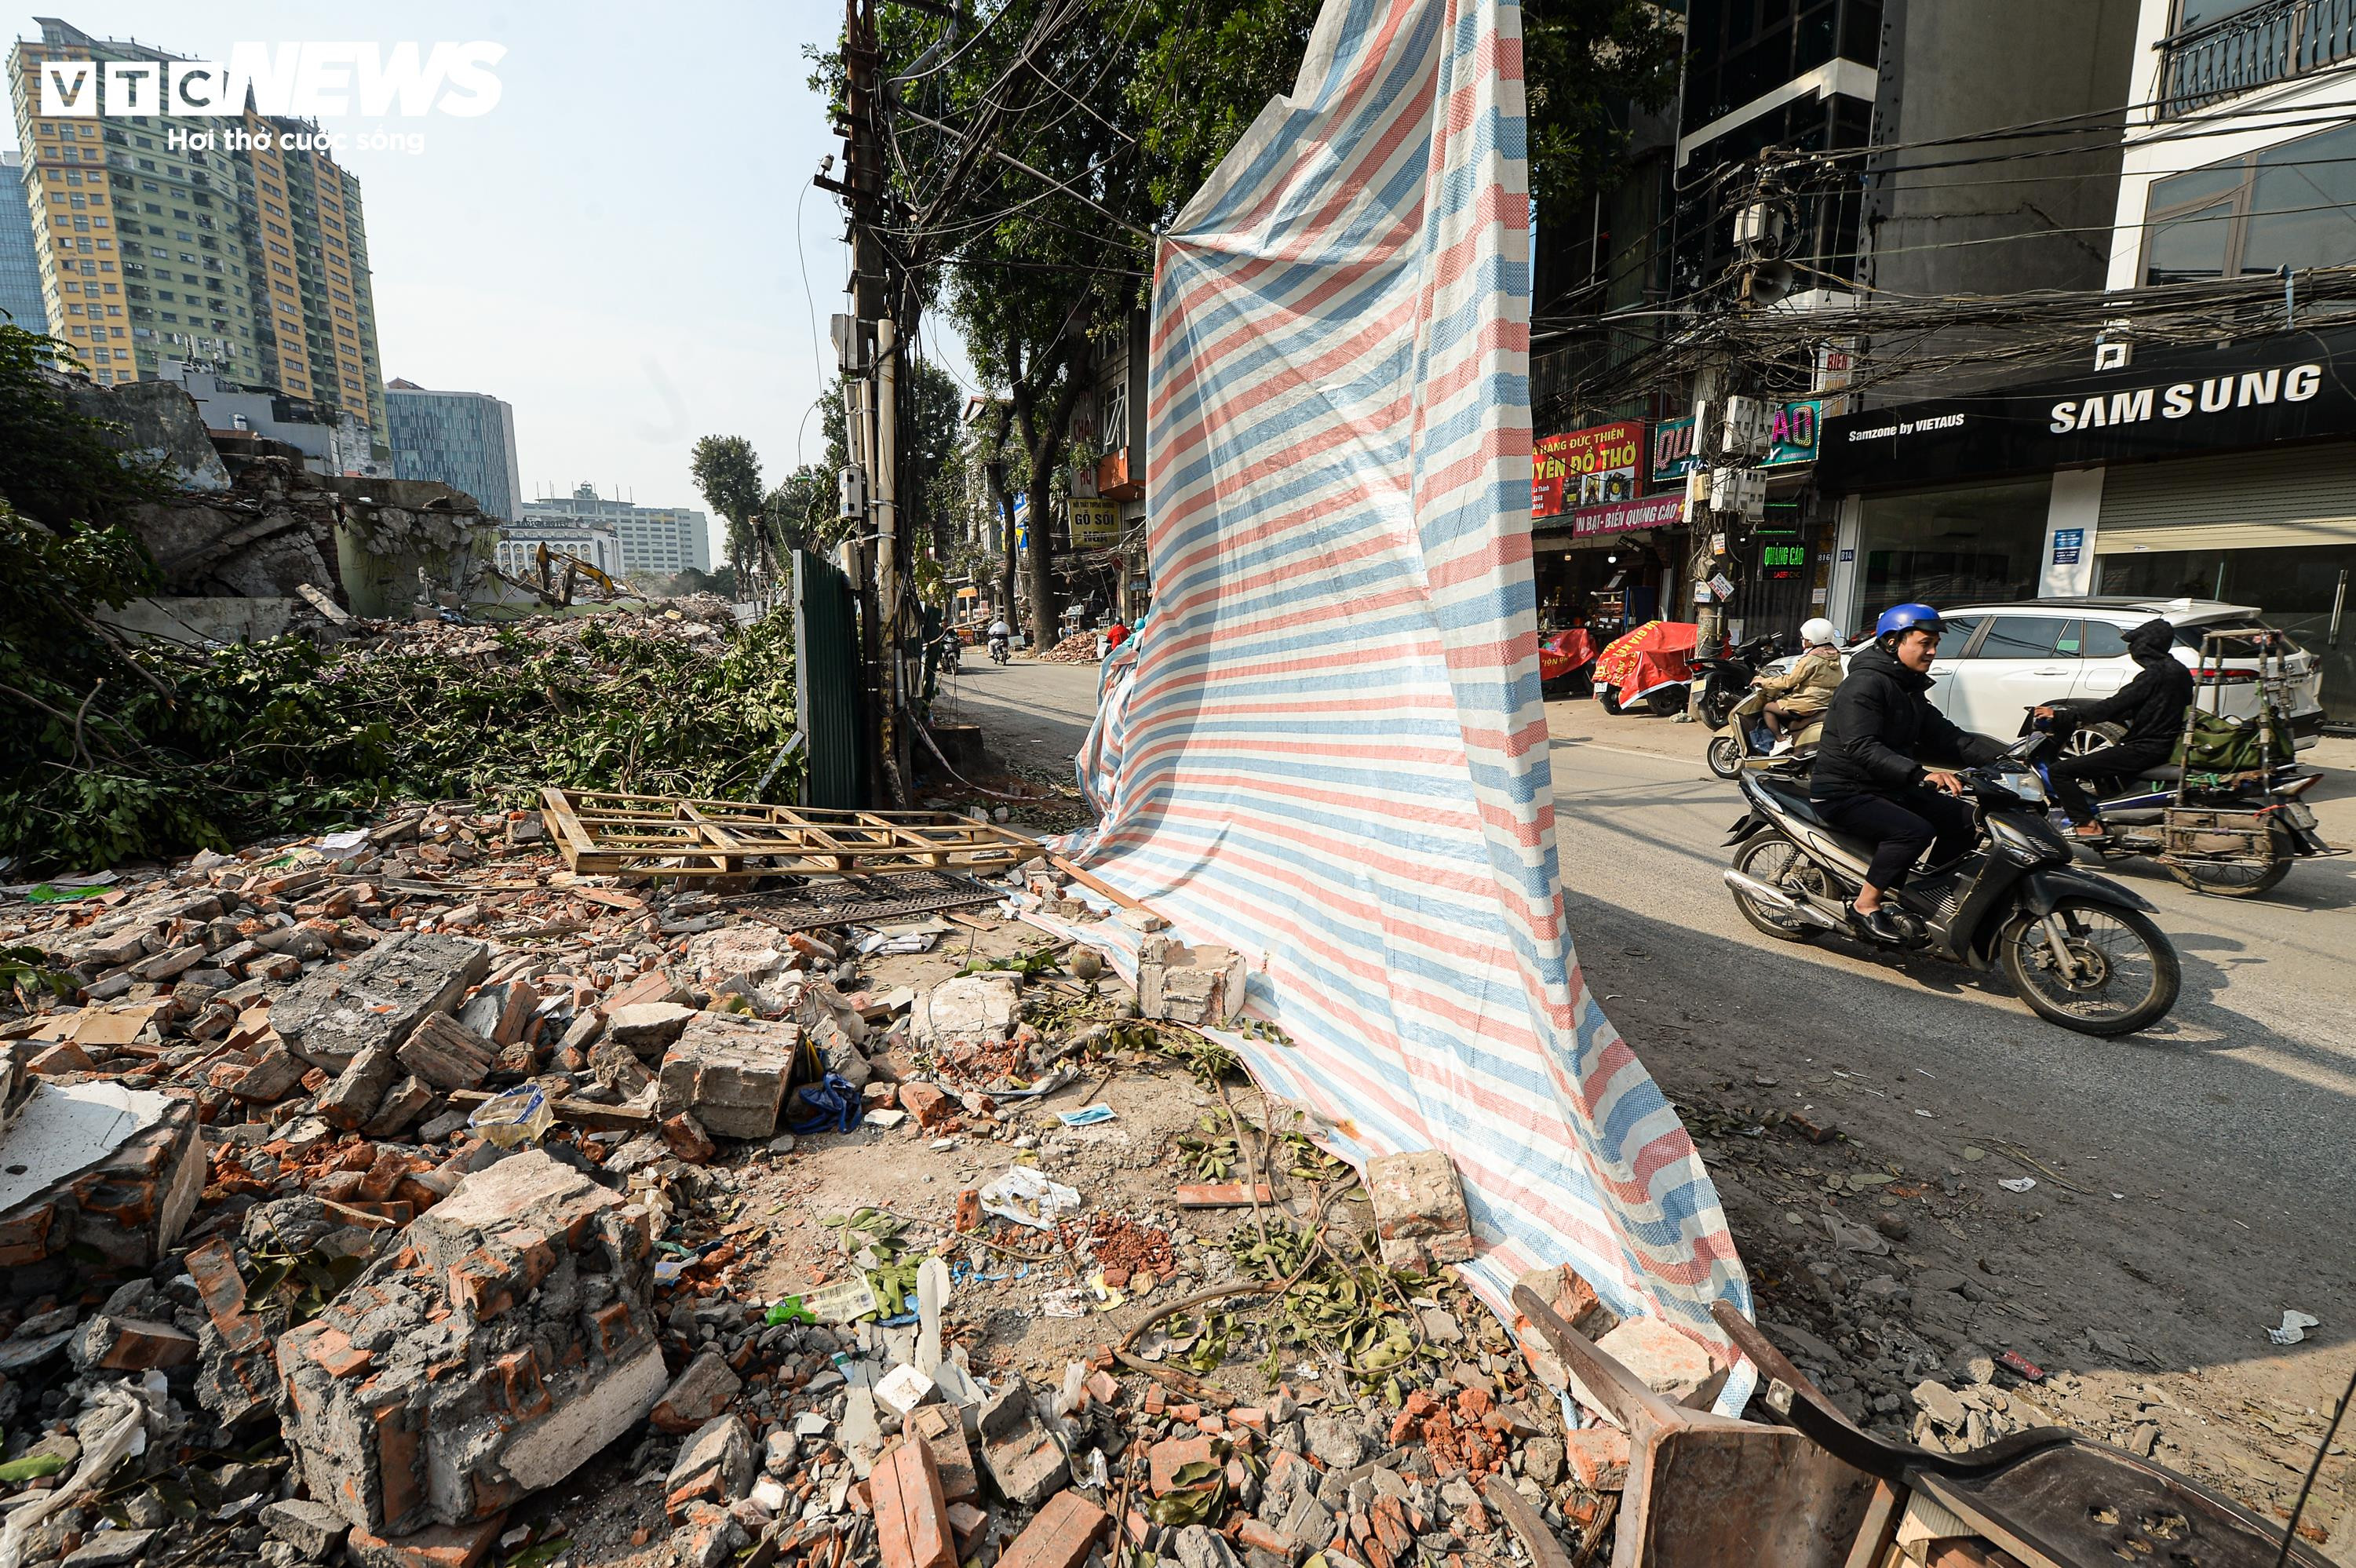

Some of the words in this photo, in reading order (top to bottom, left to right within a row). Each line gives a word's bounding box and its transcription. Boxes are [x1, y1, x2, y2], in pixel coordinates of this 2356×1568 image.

[2050, 364, 2322, 434] SAMSUNG
[1849, 426, 1897, 441] Samzone
[1900, 422, 1913, 434] by
[1916, 414, 1964, 432] VIETAUS
[1540, 440, 1566, 455] HÀNG
[1570, 434, 1591, 449] ĐỨC
[1594, 428, 1625, 443] THIỆN
[1601, 440, 1636, 470] THỜ
[1625, 501, 1657, 527] QUẢNG
[1658, 501, 1677, 520] CÁO
[1764, 542, 1789, 567] QUẢNG
[1789, 544, 1804, 565] CÁO
[1840, 551, 1852, 560] 814
